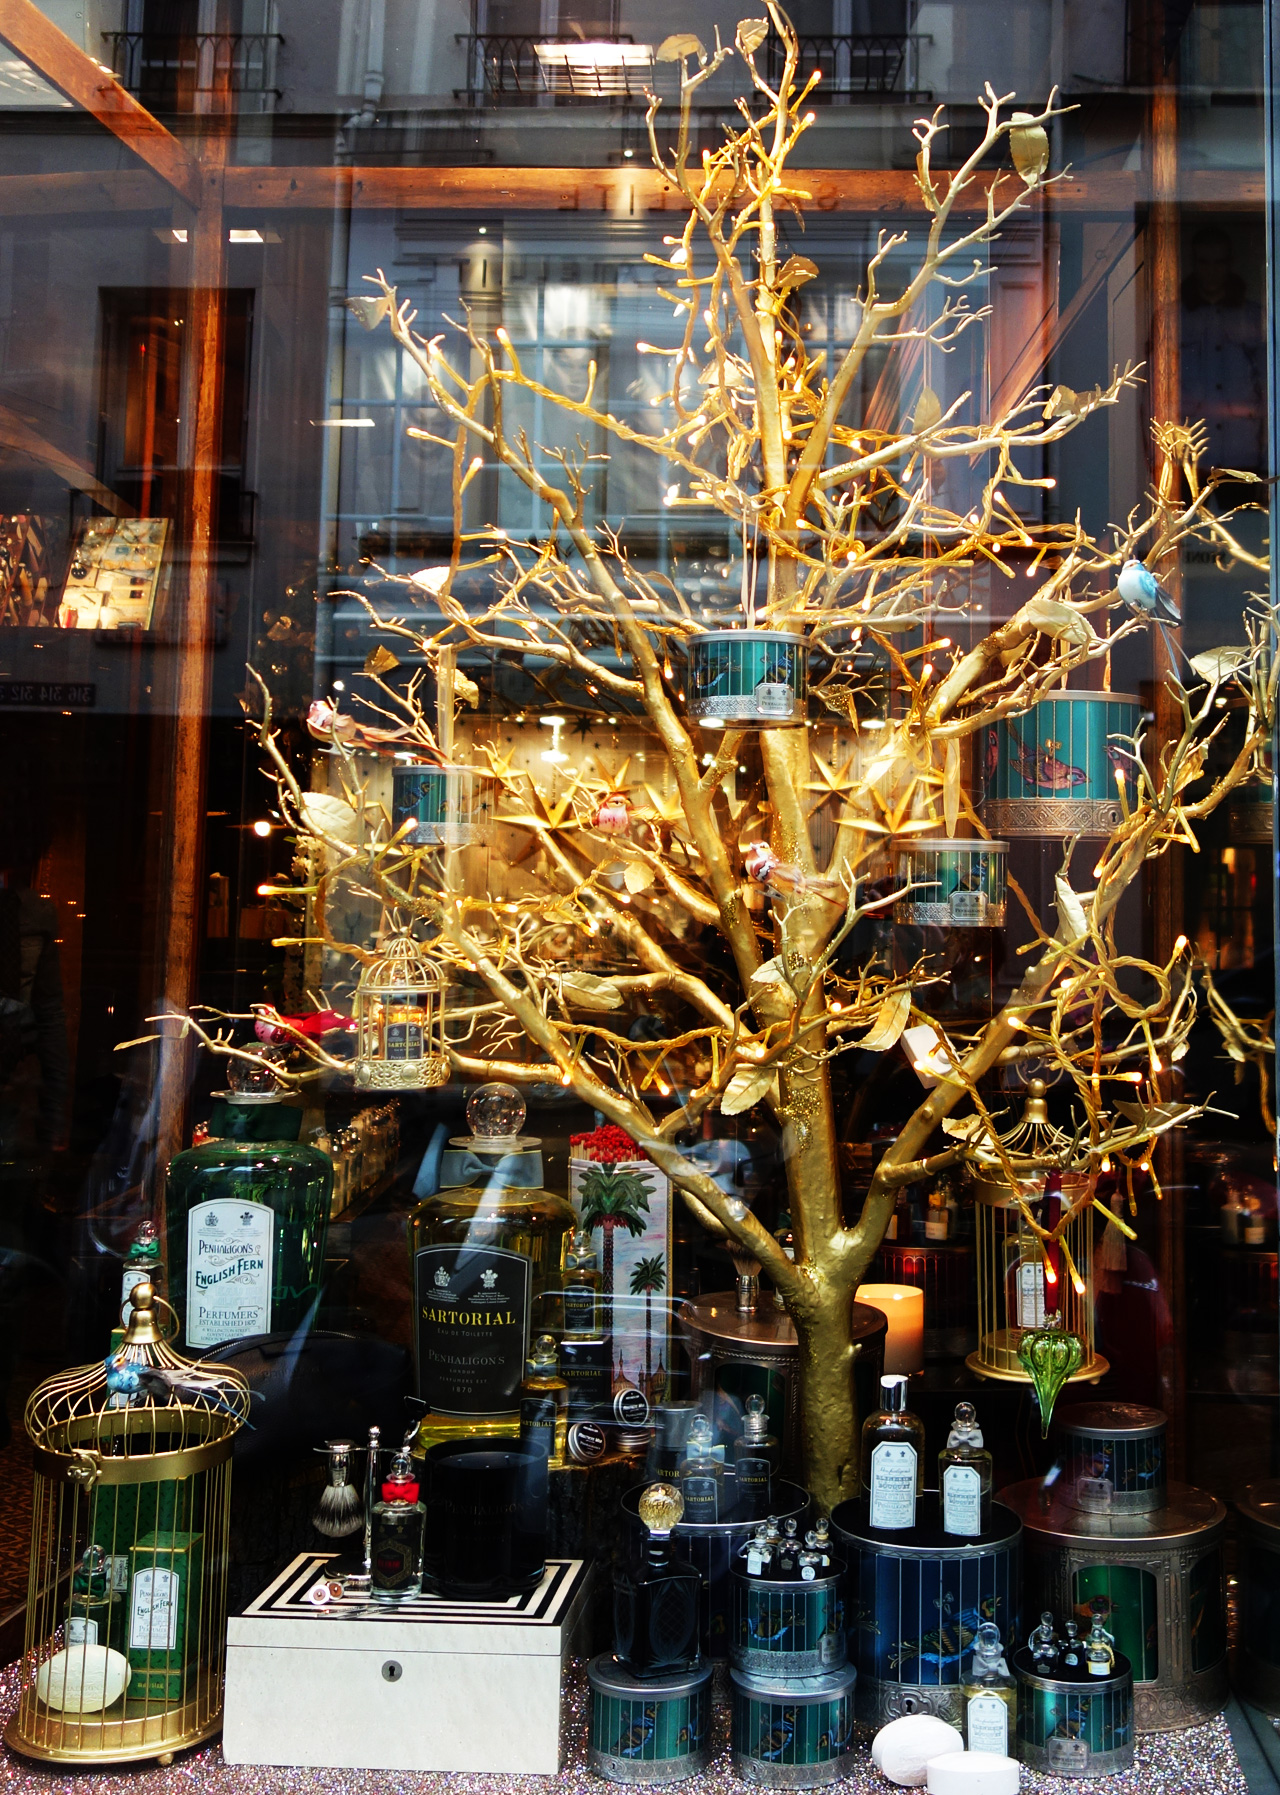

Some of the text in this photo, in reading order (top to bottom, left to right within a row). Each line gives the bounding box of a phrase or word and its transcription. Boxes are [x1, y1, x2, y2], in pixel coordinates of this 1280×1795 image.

[195, 1258, 264, 1289] ENGLISH FERN
[199, 1306, 258, 1319] PERFUMERS
[421, 1305, 517, 1327] SARTORIAL
[199, 1319, 243, 1327] ESTABLISHED
[428, 1348, 505, 1366] PENHALIGON'S
[562, 1369, 602, 1377] SARTORIAL
[452, 1386, 473, 1394] 1870
[137, 1603, 159, 1616] ENGLSH
